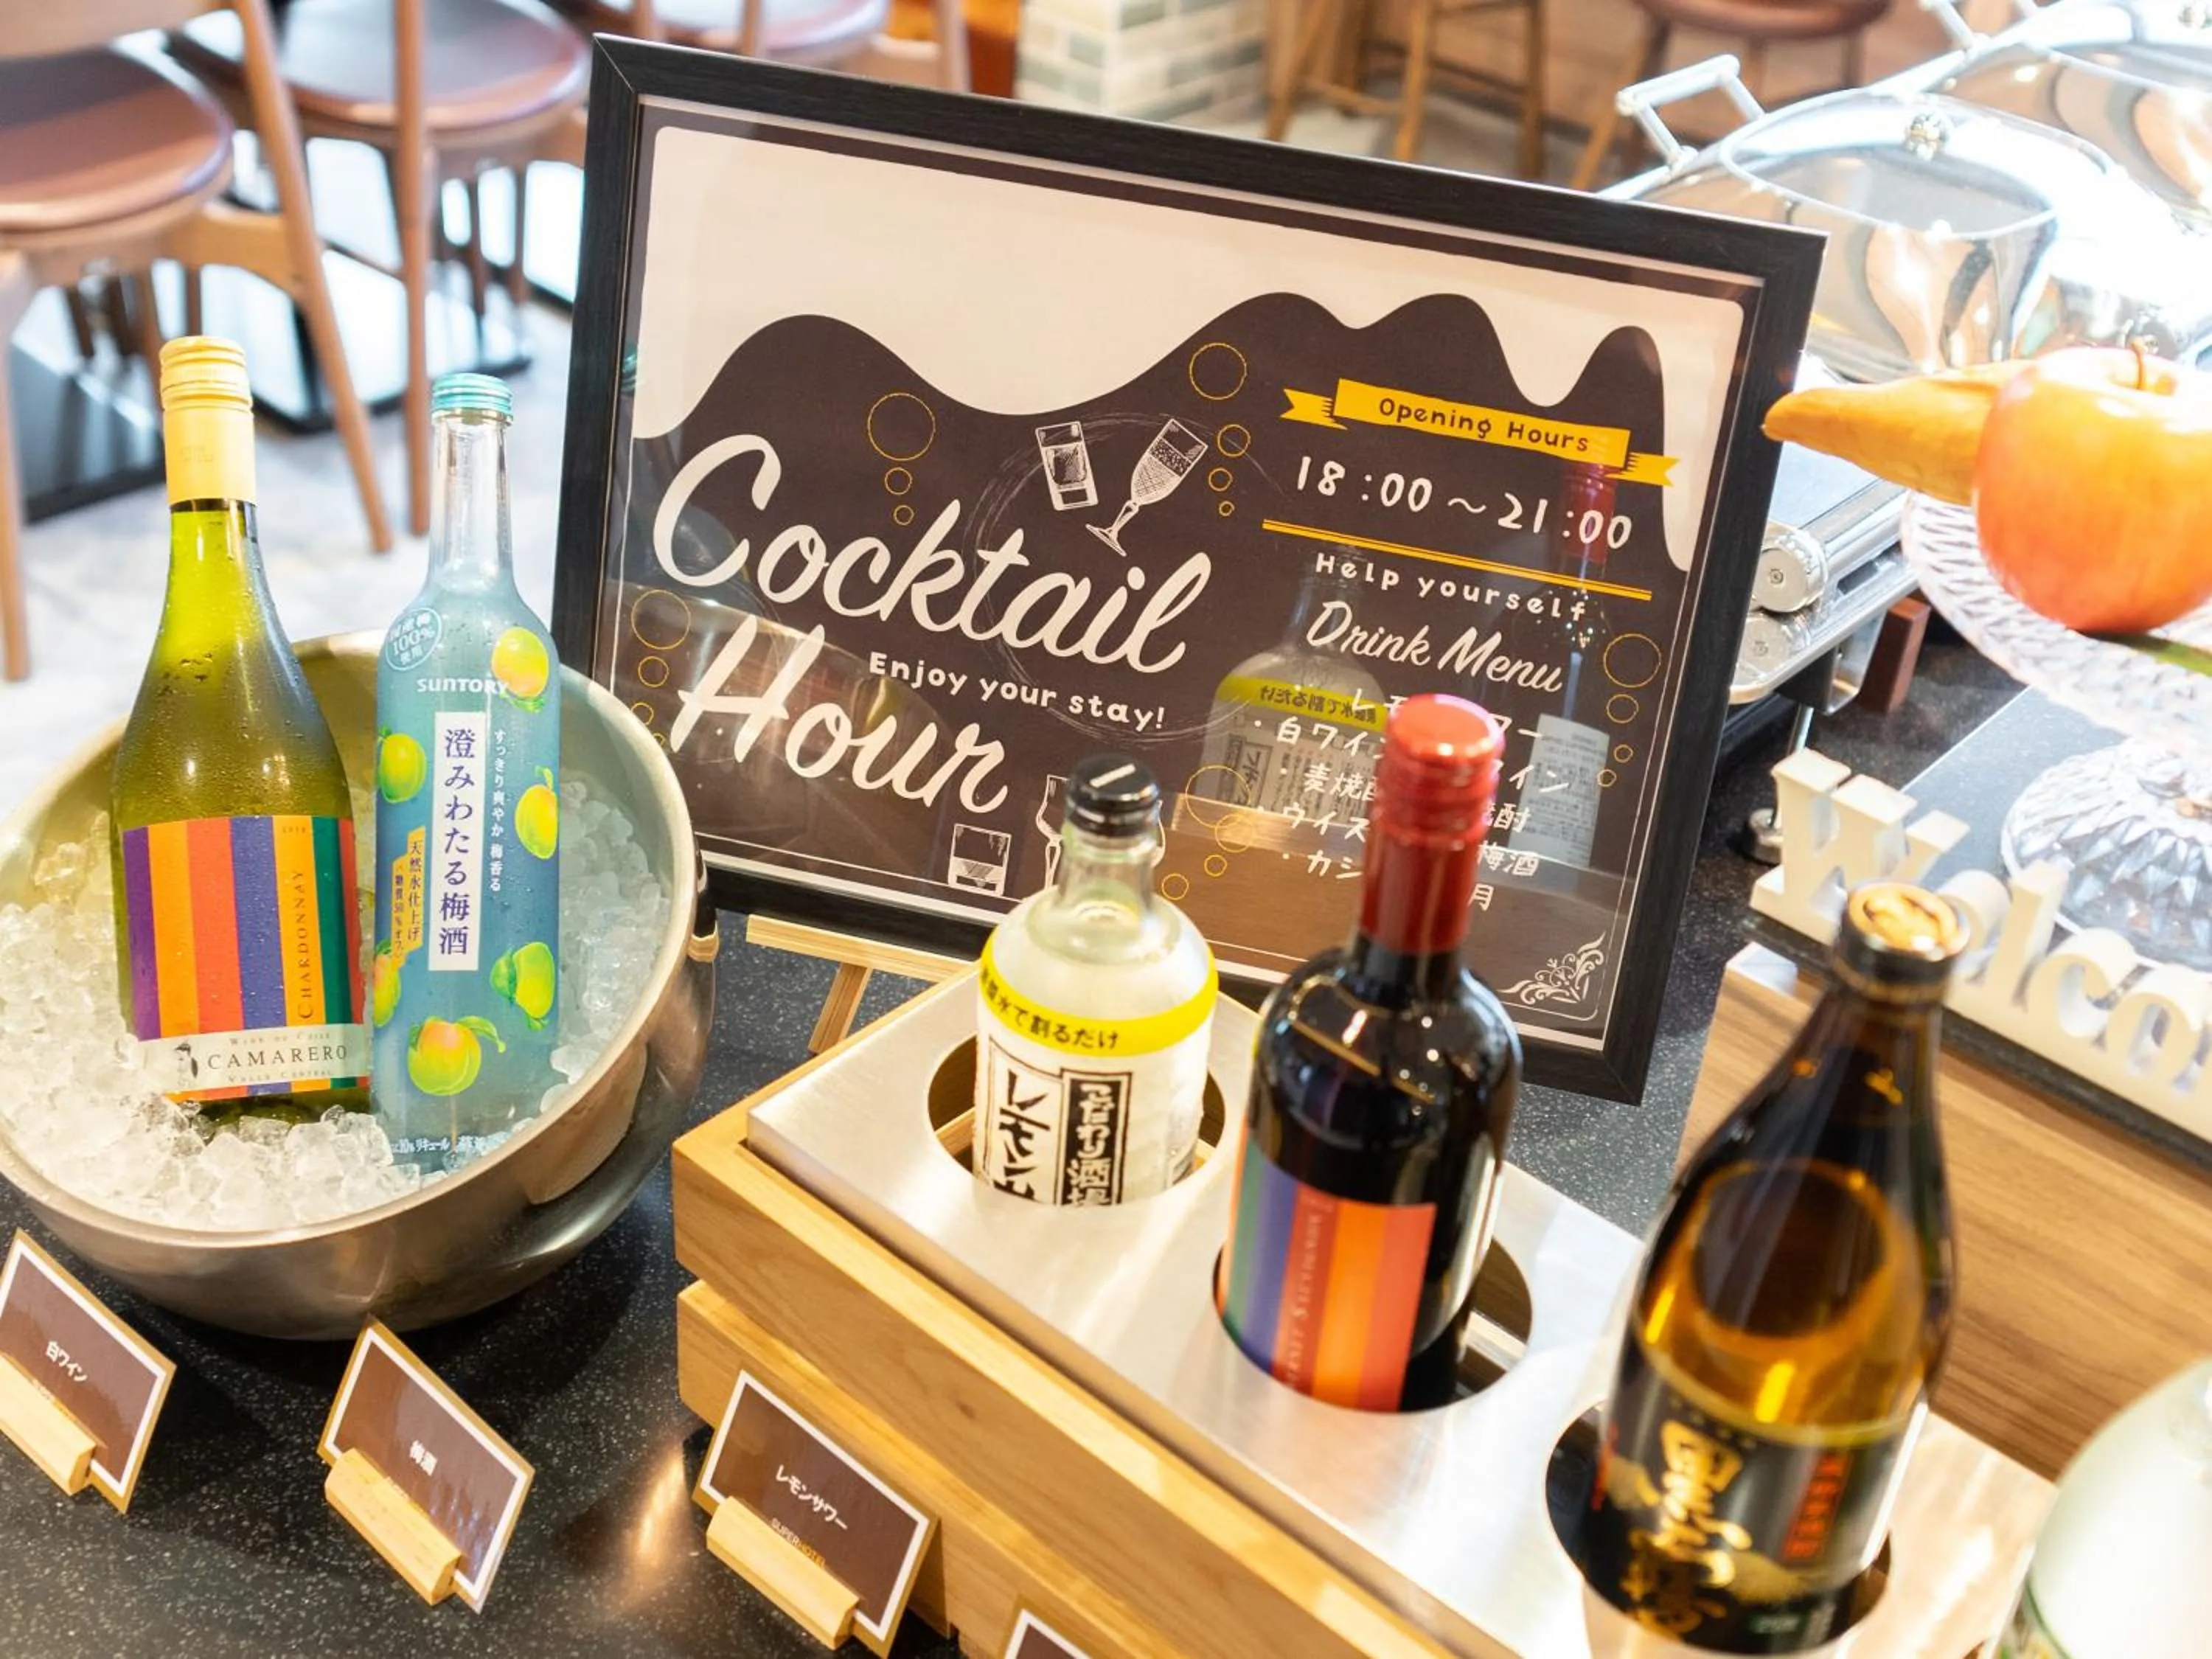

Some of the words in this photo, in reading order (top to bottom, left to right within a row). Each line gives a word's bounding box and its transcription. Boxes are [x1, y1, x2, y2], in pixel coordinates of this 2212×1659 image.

[1379, 397, 1492, 439] Opening
[1507, 422, 1589, 452] Hours
[653, 434, 1212, 674] Cocktail
[1315, 552, 1399, 591] Help
[1417, 577, 1587, 622] yourself
[1306, 601, 1431, 667] Drink
[1437, 626, 1563, 692] Menu
[669, 613, 1009, 814] Hour
[870, 651, 967, 698] Enjoy
[979, 676, 1057, 709] your
[1068, 690, 1166, 731] stay!
[439, 728, 476, 955] 澄みわたる梅酒
[208, 1045, 347, 1070] CAMARERO
[44, 1340, 88, 1382] 白ワイン
[776, 1464, 849, 1531] レモンサワー
